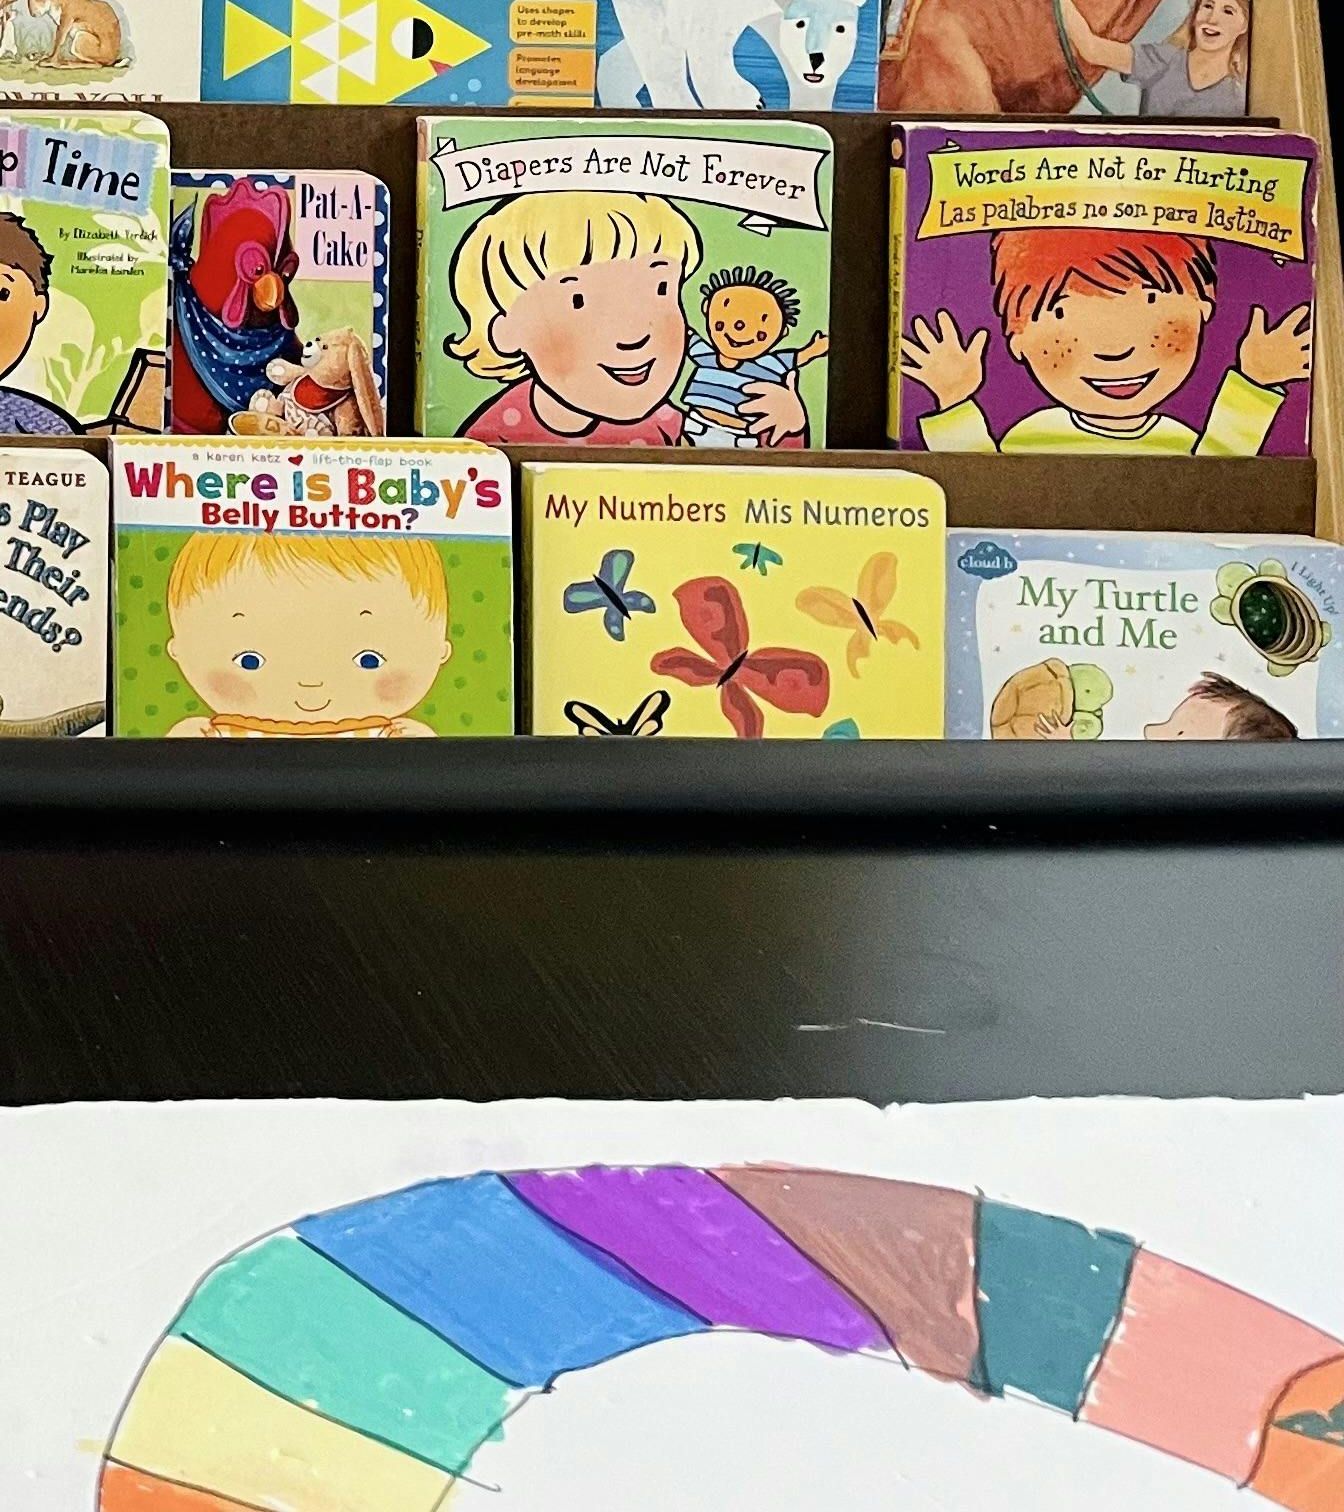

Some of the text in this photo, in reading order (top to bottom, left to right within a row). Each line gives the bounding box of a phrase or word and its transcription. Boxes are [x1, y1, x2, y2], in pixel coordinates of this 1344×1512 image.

[530, 18, 567, 27] develop
[42, 138, 140, 201] Time
[456, 148, 805, 199] Diapers Are Not Forever
[300, 183, 372, 220] Pat-A-
[313, 230, 368, 267] Cake
[5, 472, 86, 487] TEAGUE
[124, 461, 502, 518] Where is Baby's
[201, 502, 419, 535] Belly Button?
[545, 494, 930, 528] My Numbers Mis Numeros
[960, 555, 1012, 568] cloud b
[1017, 576, 1199, 618] My Turtle
[1039, 615, 1178, 649] and Me
